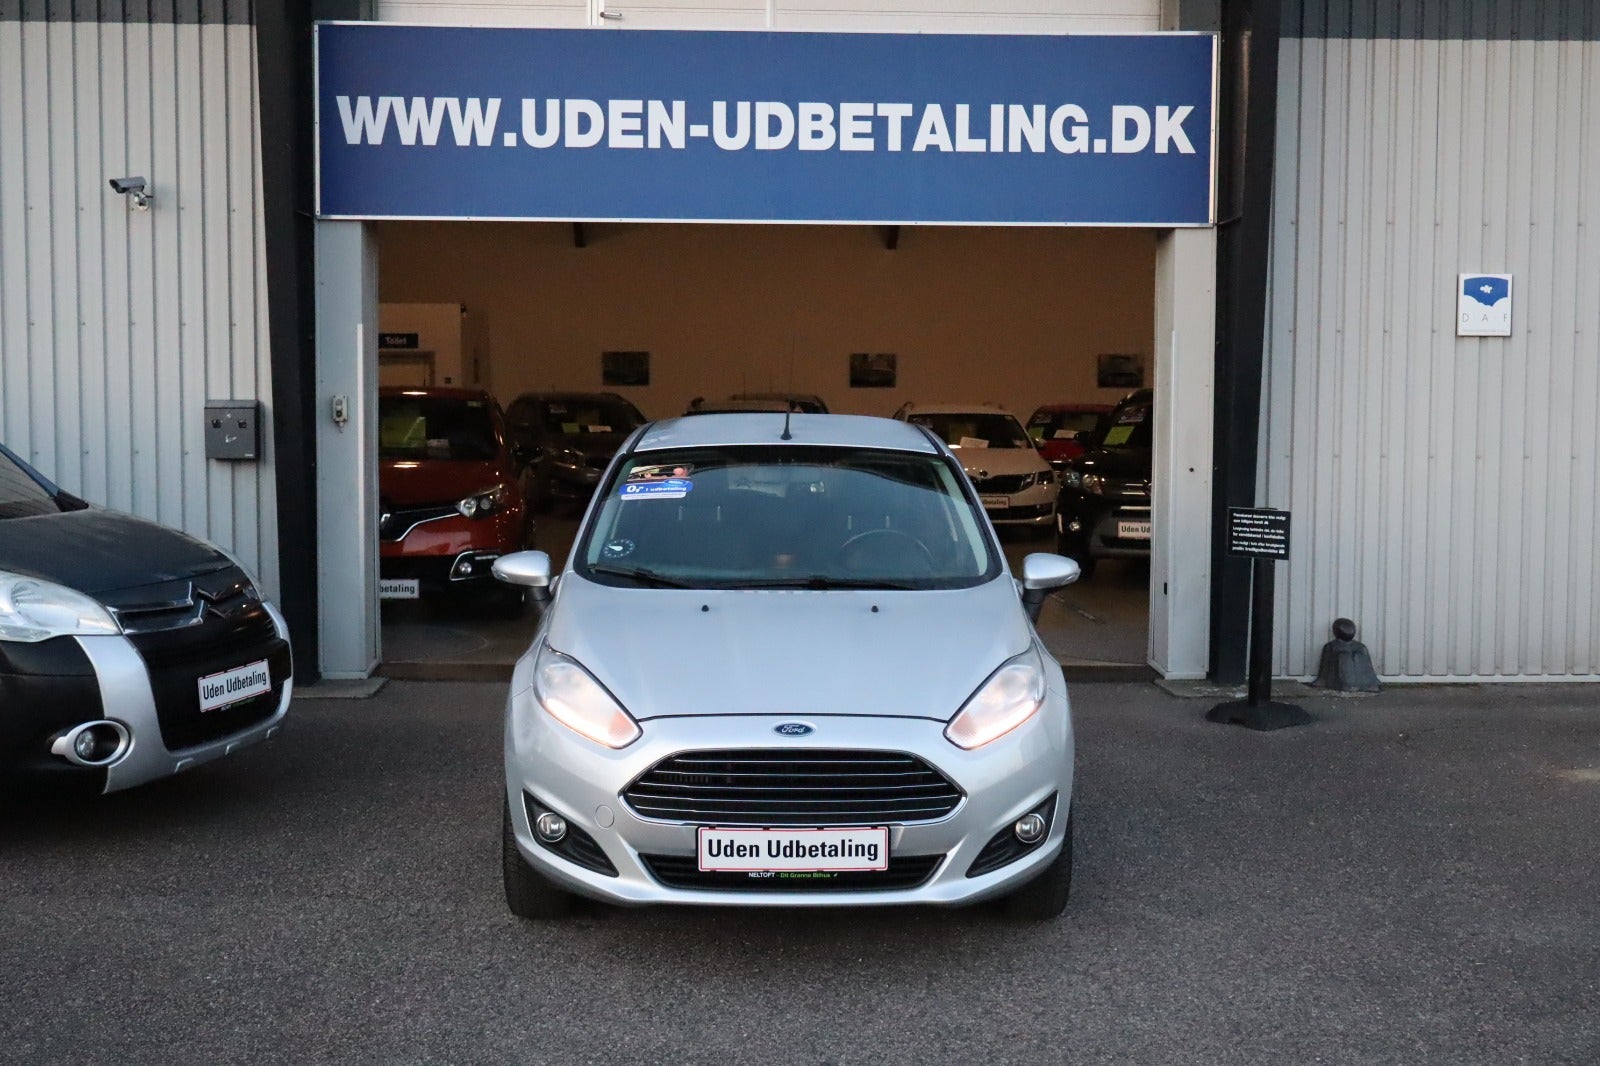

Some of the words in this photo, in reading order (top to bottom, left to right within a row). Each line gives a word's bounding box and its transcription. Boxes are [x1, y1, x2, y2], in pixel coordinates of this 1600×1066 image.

[336, 95, 1197, 154] WWW.UDEN-UDBETALING.DK
[1121, 525, 1139, 533] Uden
[380, 584, 415, 594] betaling
[203, 684, 225, 700] Uden
[226, 671, 267, 693] Udbetaling
[781, 724, 806, 733] Ford
[708, 839, 760, 858] Uden
[767, 839, 879, 861] Udbetaling
